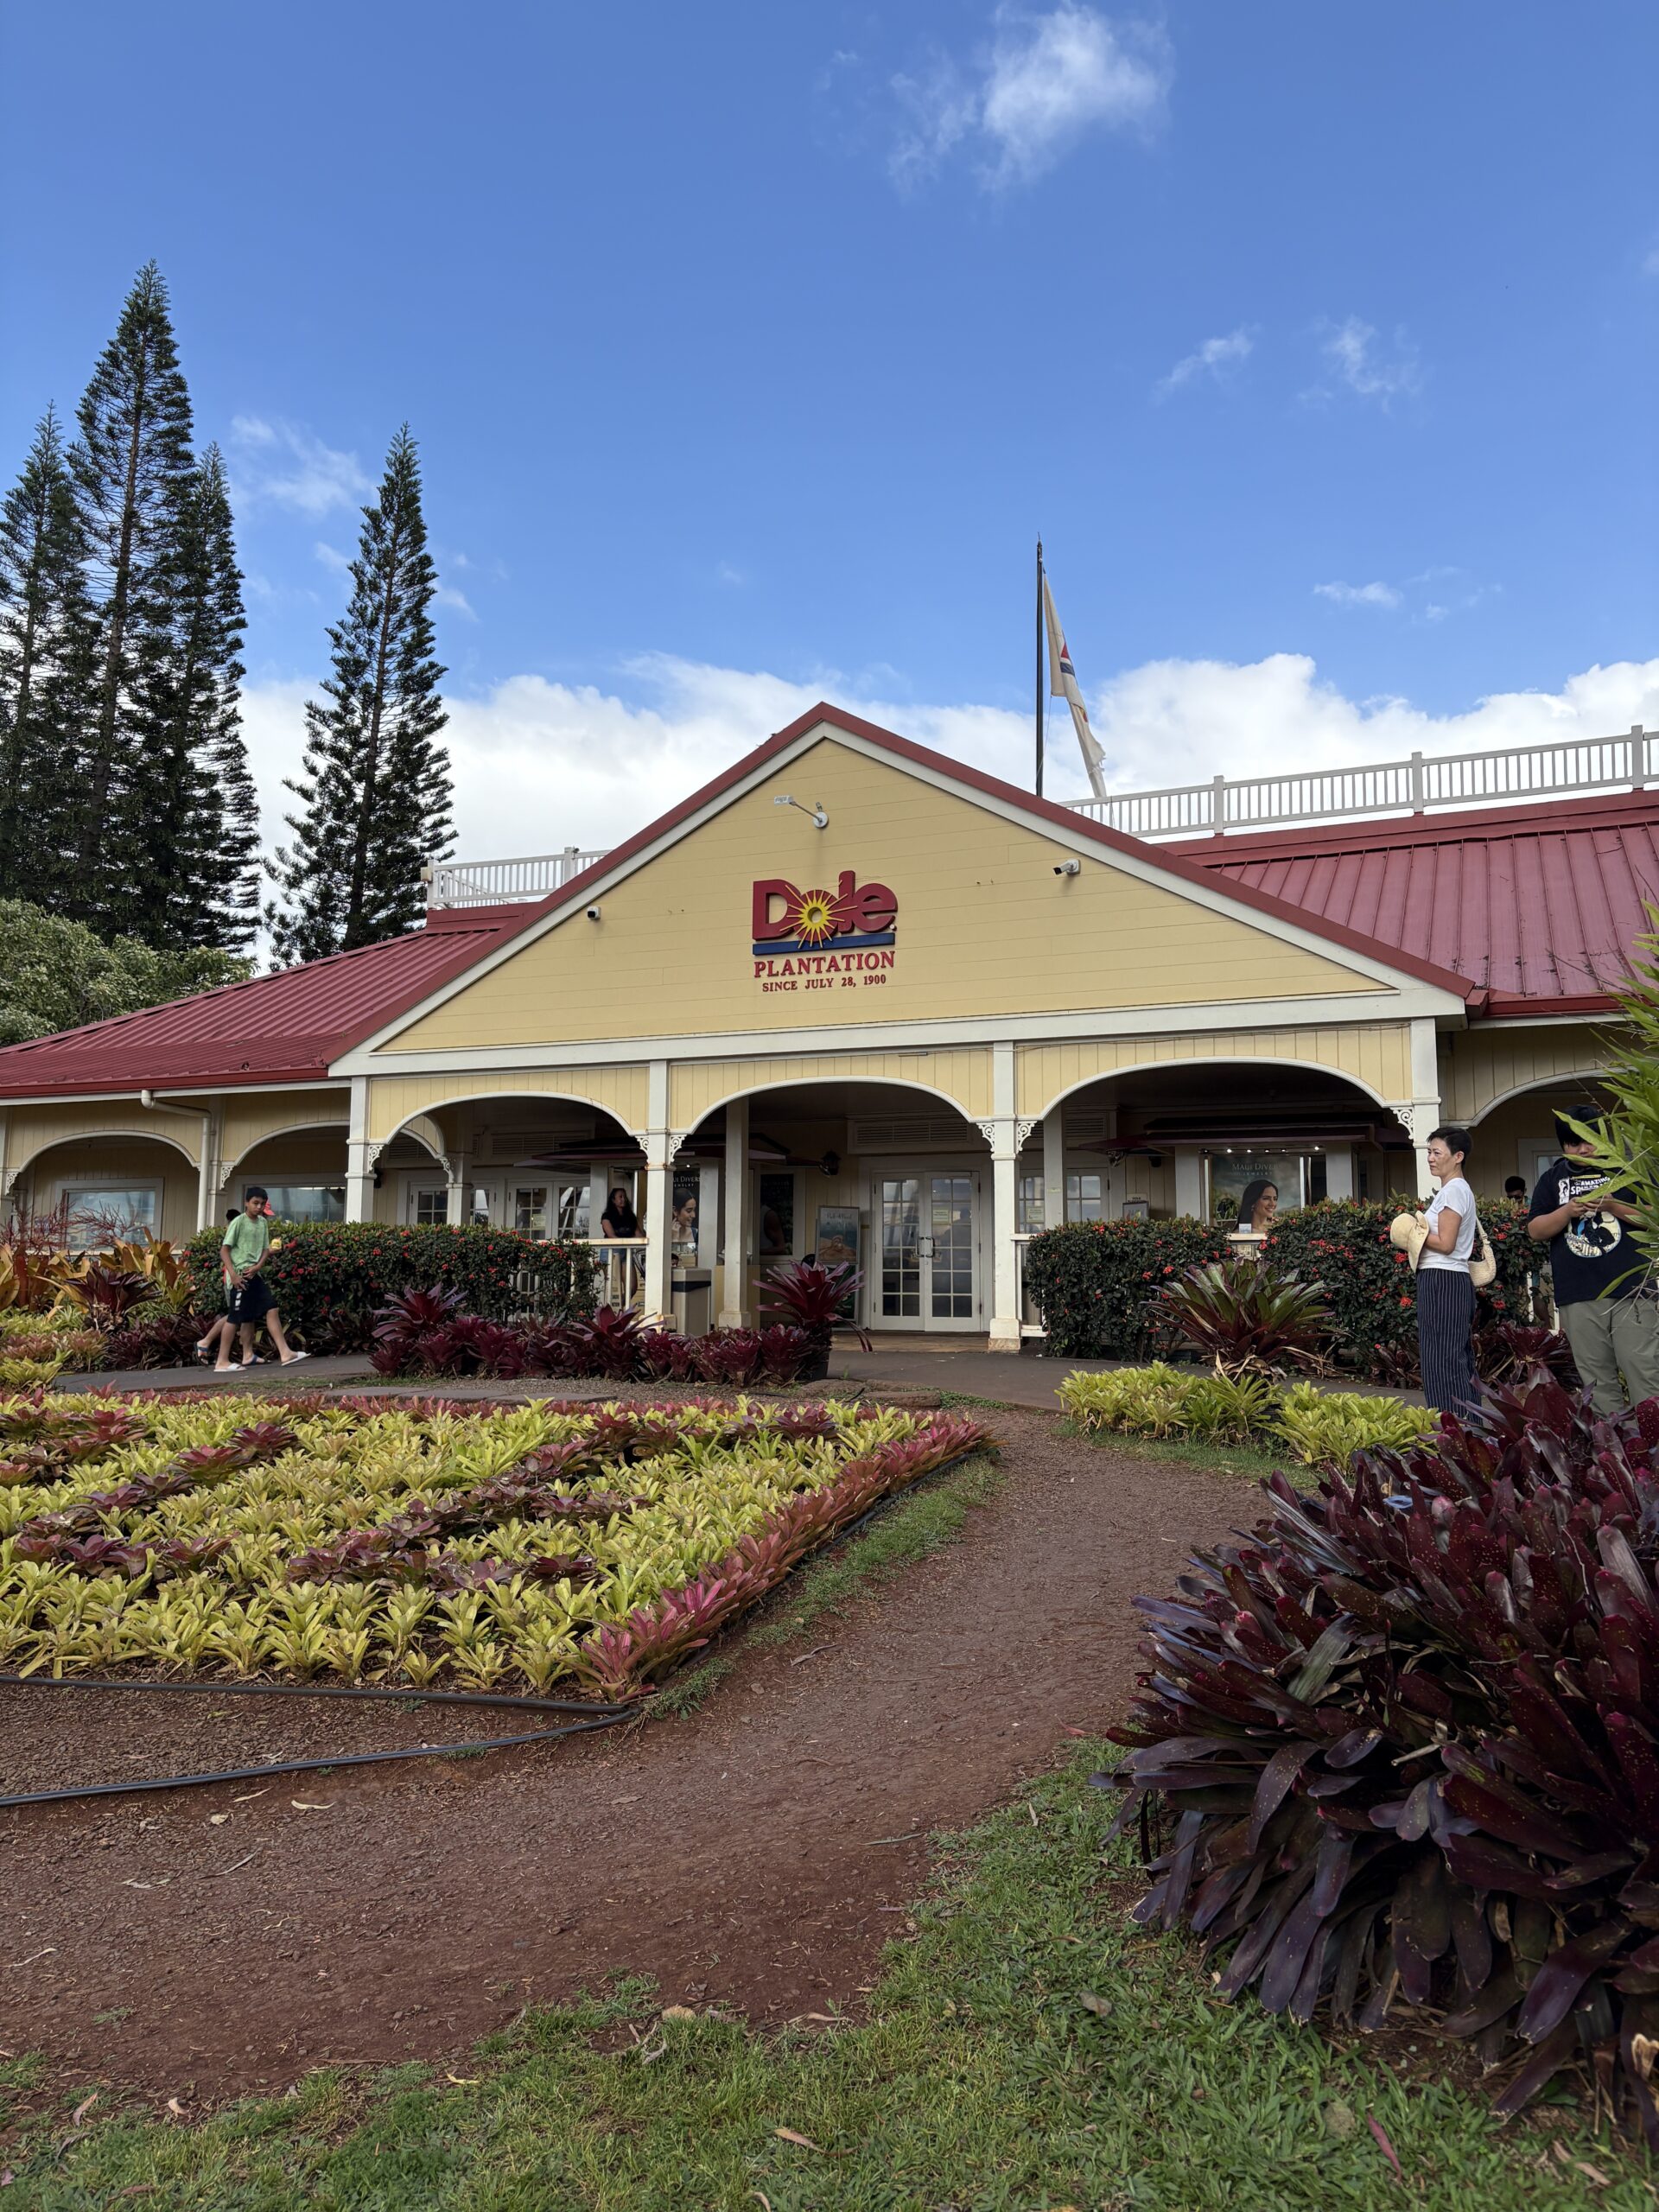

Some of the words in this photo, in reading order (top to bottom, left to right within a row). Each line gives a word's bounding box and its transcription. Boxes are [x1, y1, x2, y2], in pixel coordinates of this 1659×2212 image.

[752, 870, 899, 941] Dole
[753, 950, 895, 977] PLANTATION
[762, 981, 798, 992] SINCE
[804, 978, 834, 989] JULY
[841, 976, 856, 988] 28,
[863, 974, 887, 985] 1900
[1581, 1176, 1611, 1186] AMAZING
